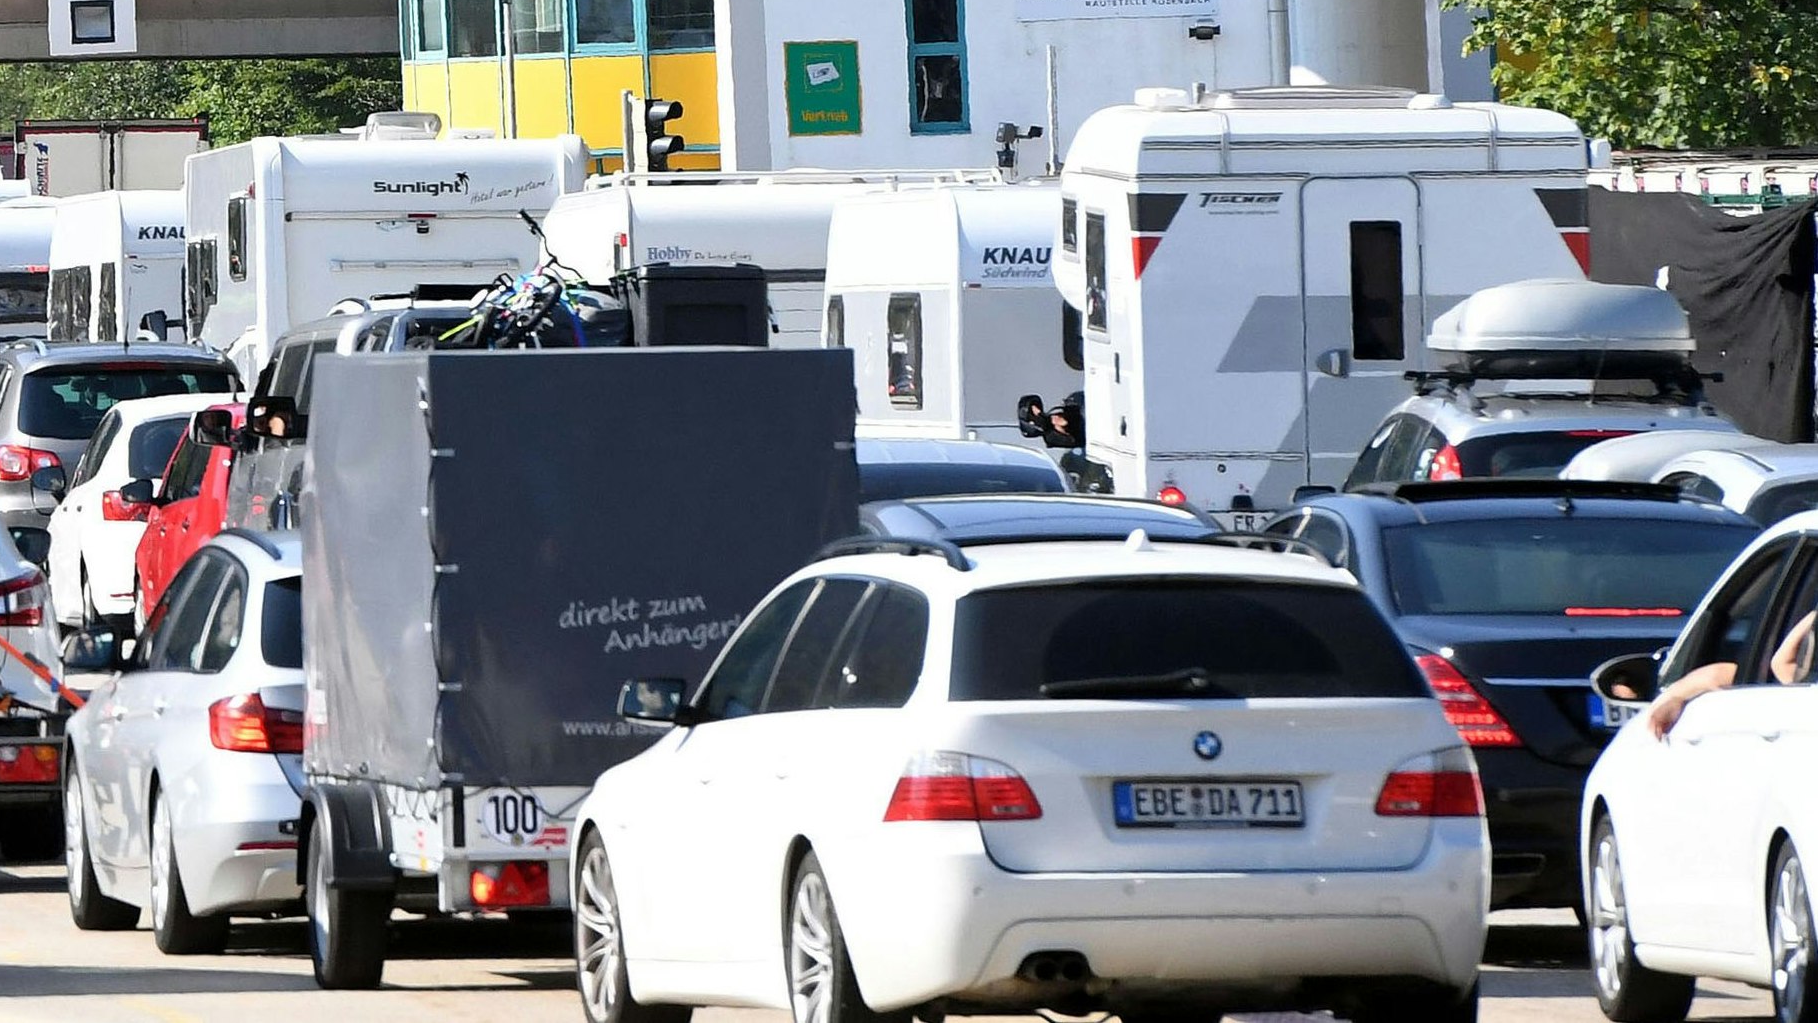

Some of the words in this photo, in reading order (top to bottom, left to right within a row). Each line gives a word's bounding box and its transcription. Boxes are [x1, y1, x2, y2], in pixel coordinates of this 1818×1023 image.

[373, 180, 462, 196] Sunlight
[647, 246, 692, 262] Hobby
[982, 247, 1053, 264] KNAU
[981, 266, 1049, 278] Südwind
[558, 597, 640, 629] direkt
[647, 594, 707, 619] zum
[1135, 788, 1187, 816] EBE
[1208, 788, 1242, 816] DA
[1249, 788, 1299, 816] 711
[488, 794, 538, 835] 100
